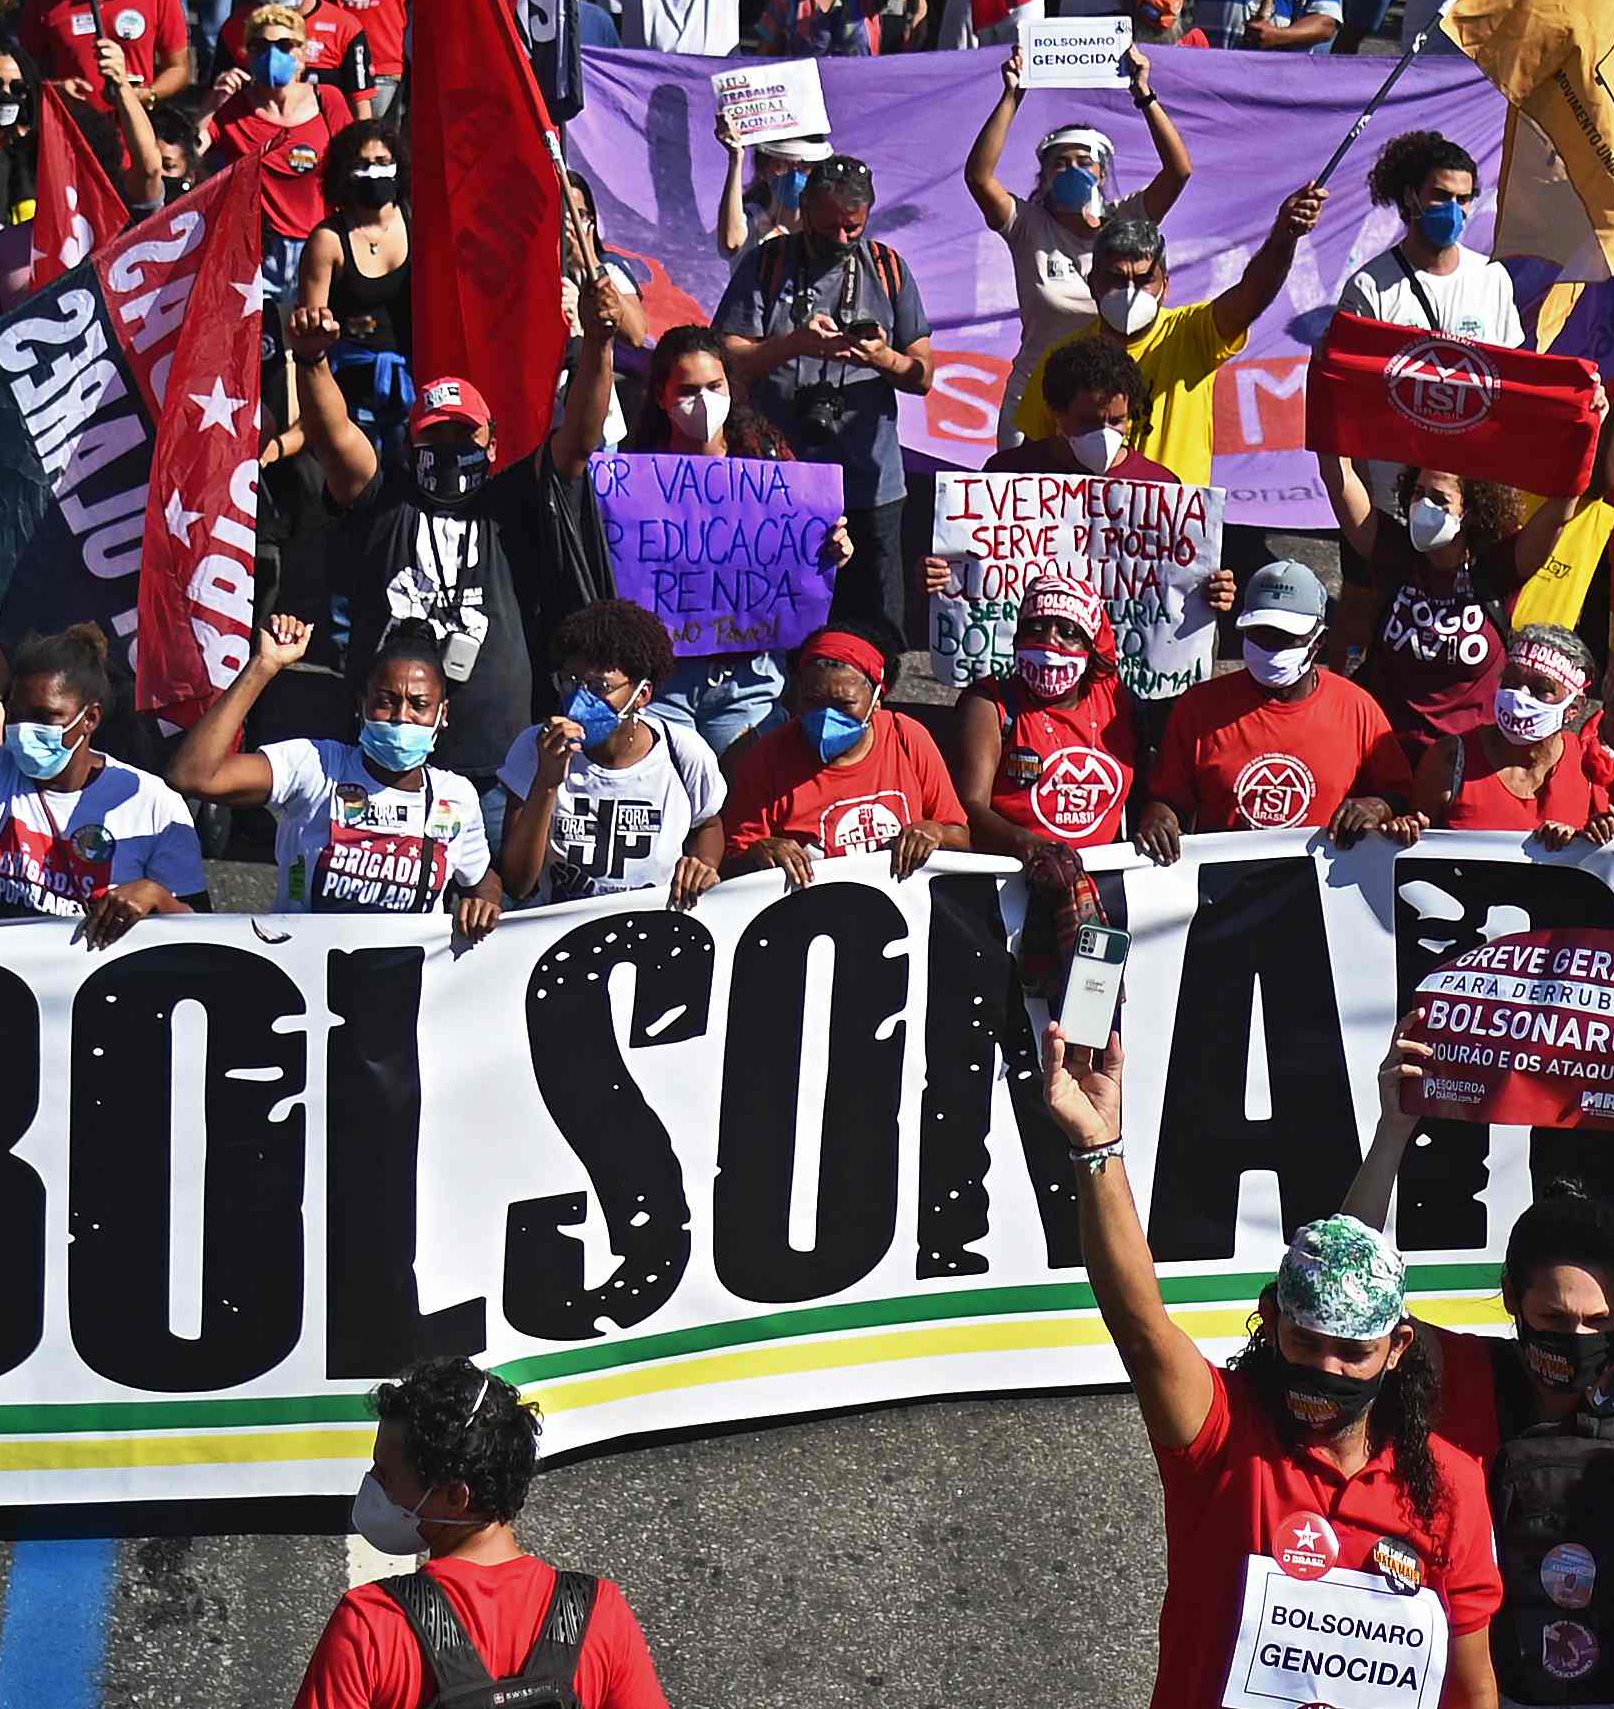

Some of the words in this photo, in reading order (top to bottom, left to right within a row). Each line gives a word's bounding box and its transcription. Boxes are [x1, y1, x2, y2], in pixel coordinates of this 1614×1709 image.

[1031, 53, 1118, 67] GENOCIDA
[1033, 35, 1117, 48] BOLSONARO
[1554, 68, 1602, 151] MOVIMENTO
[651, 456, 795, 508] VACINA
[945, 476, 1208, 539] IVERMECTINA
[637, 510, 831, 573] EDUCAÇÃO
[965, 525, 1060, 561] SERVE
[1100, 526, 1197, 568] PIOLHO
[650, 568, 803, 614] RENDA
[617, 805, 652, 826] FORA
[1055, 811, 1095, 825] BRASIL
[330, 843, 440, 888] BRIGADAS
[1456, 940, 1547, 976] GREVE
[1440, 973, 1501, 999] PARA
[1496, 1050, 1511, 1069] E
[1513, 1051, 1542, 1073] OS
[1435, 1077, 1487, 1097] ESQUERDA
[1291, 1555, 1327, 1568] BRASIL
[1271, 1604, 1426, 1650] BOLSONARO
[1258, 1642, 1419, 1692] GENOCIDA
